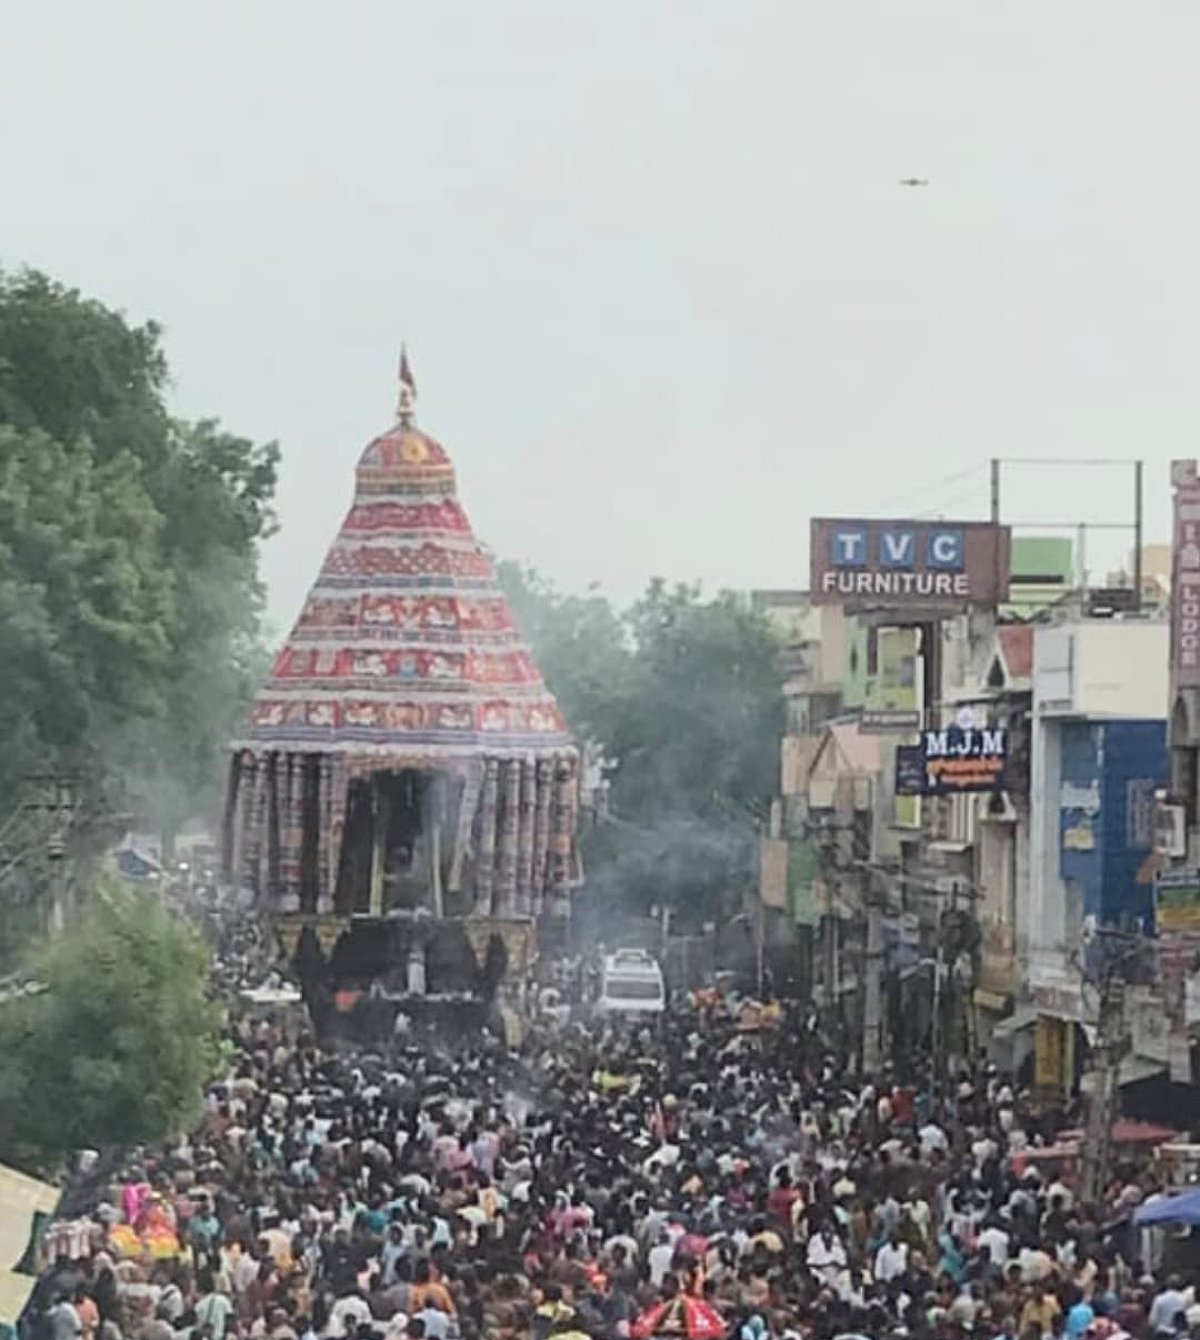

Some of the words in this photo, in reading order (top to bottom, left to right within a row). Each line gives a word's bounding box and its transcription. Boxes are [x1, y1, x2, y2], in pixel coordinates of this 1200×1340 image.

[837, 532, 957, 562] TVC
[822, 571, 970, 595] FURNITURE
[925, 731, 1004, 756] M.J.M
